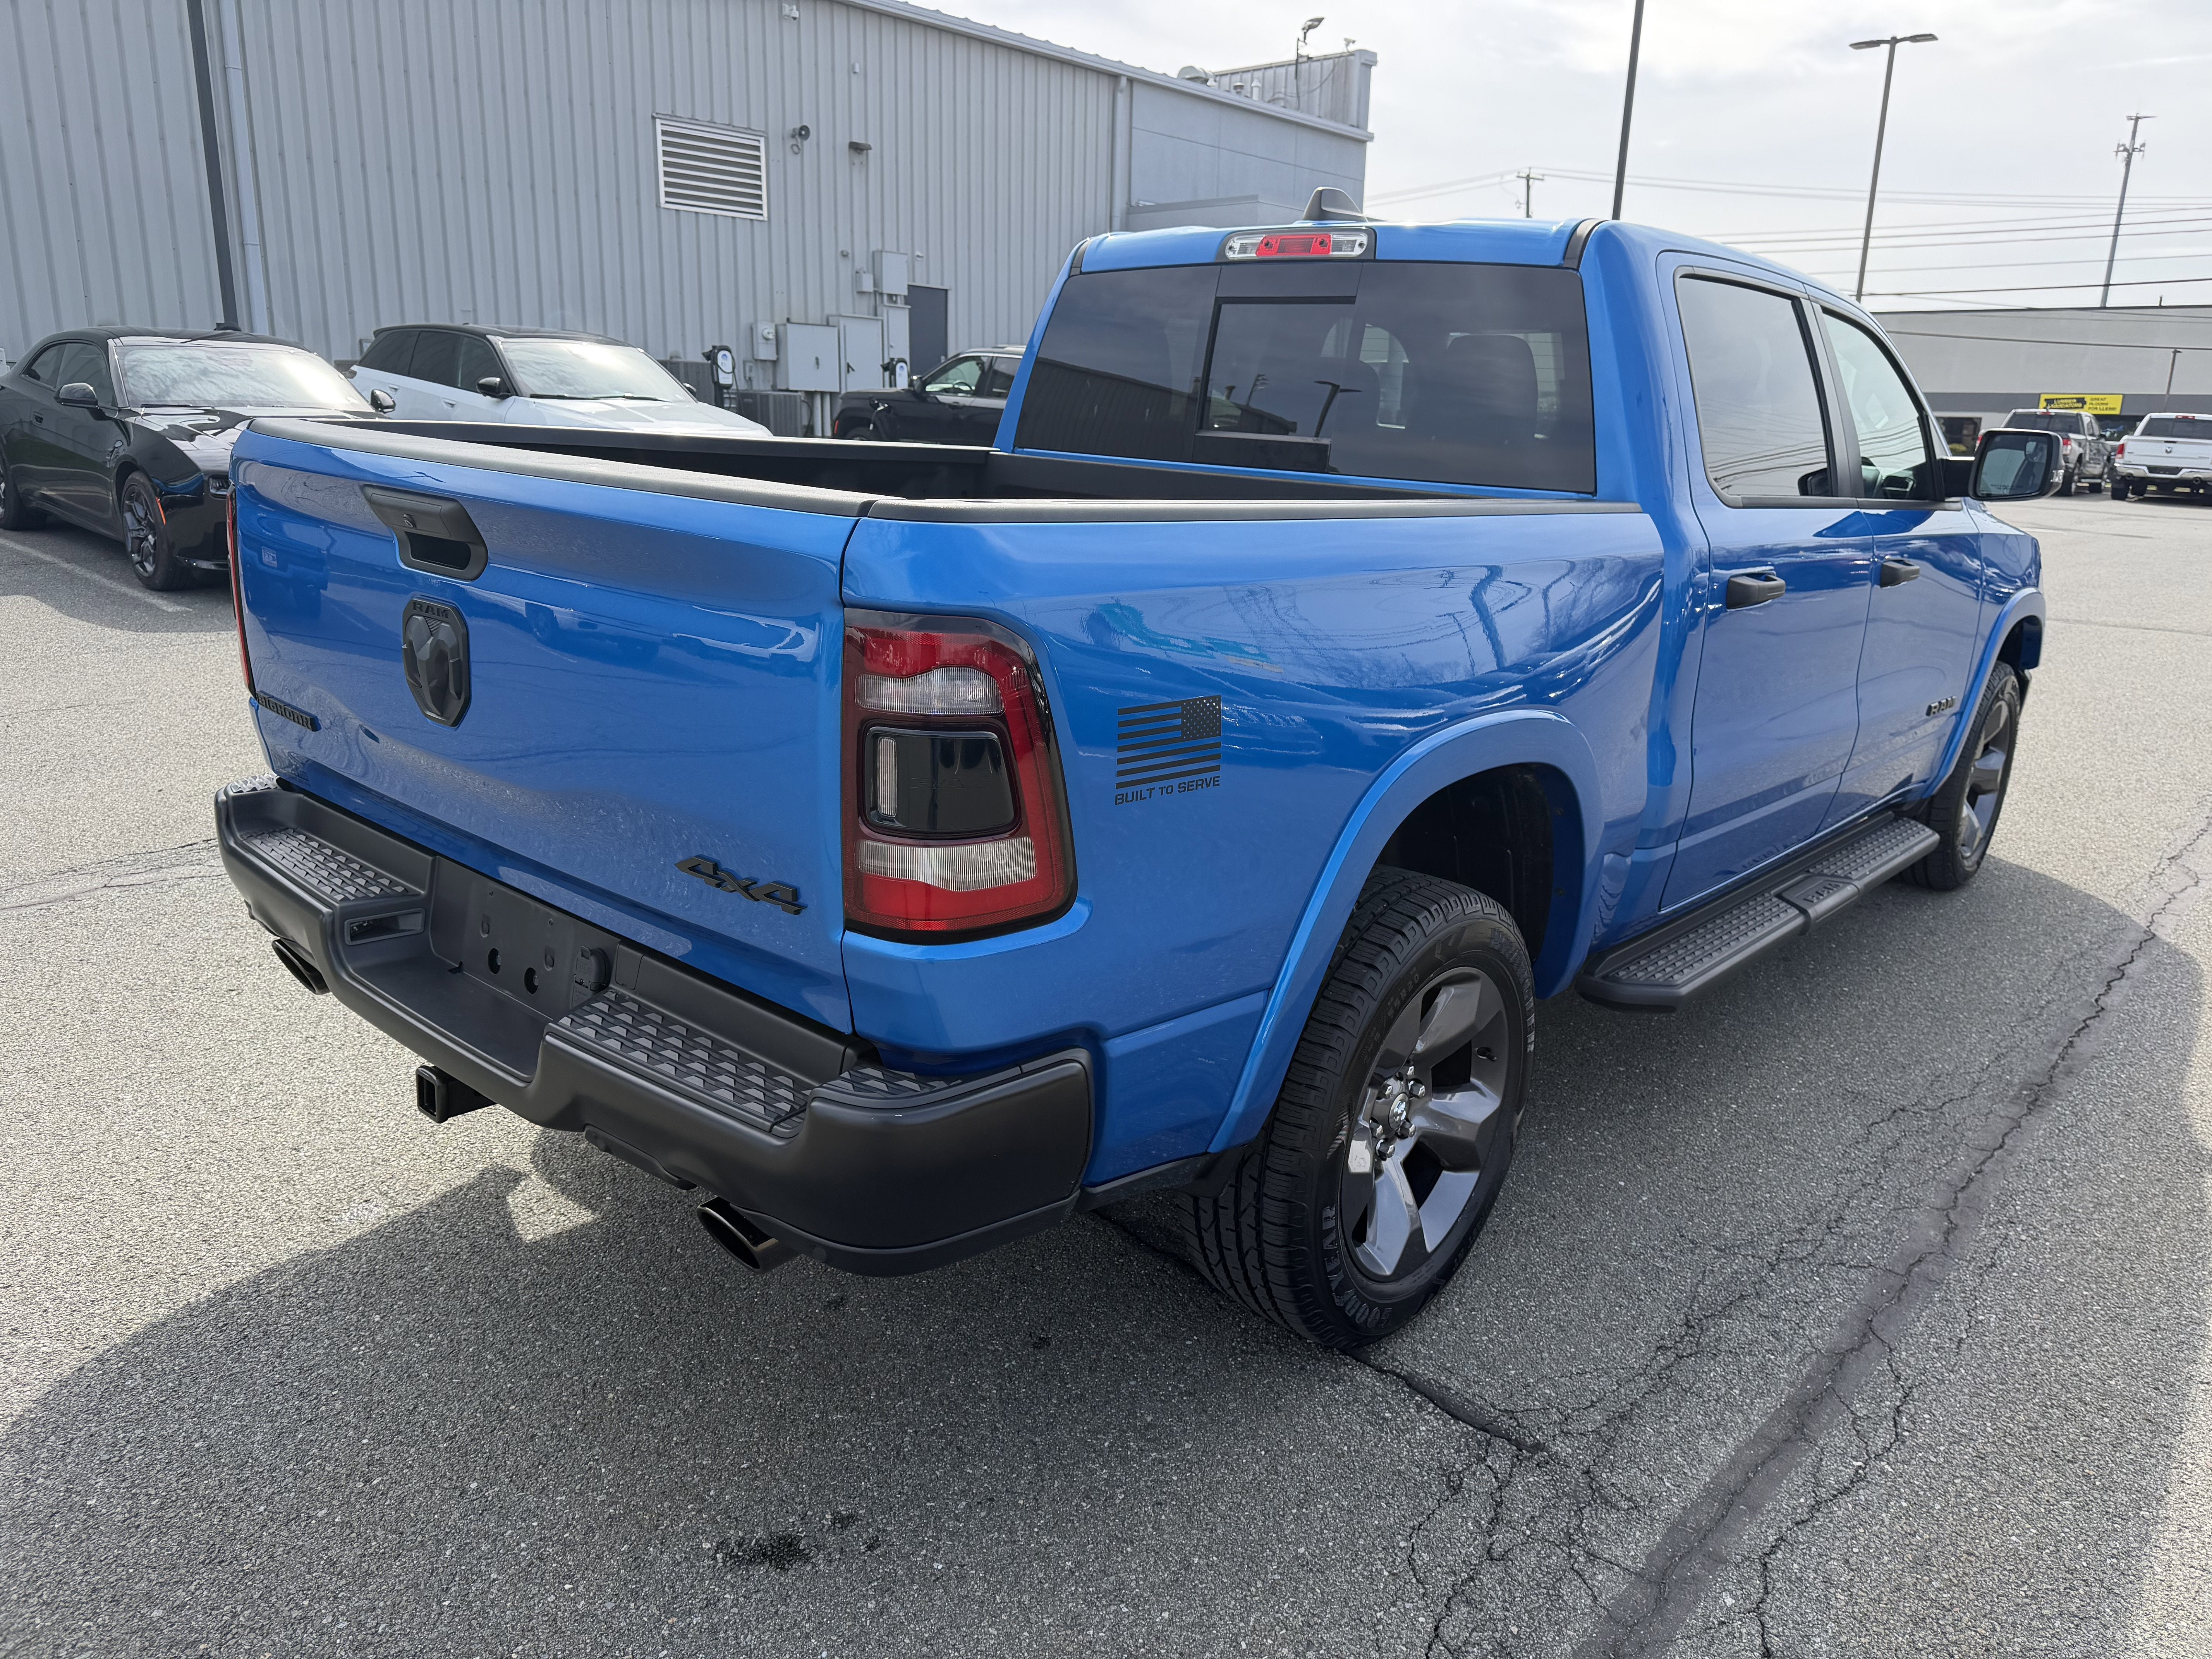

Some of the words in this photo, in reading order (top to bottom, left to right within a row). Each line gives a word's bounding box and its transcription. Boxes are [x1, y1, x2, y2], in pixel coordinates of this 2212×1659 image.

[413, 601, 449, 619] RAM
[1926, 696, 1957, 716] RAM
[1115, 787, 1155, 805] BUILT
[1159, 785, 1174, 795] TO
[1178, 775, 1221, 793] SERVE
[1321, 1204, 1393, 1328] GOODYEAR
